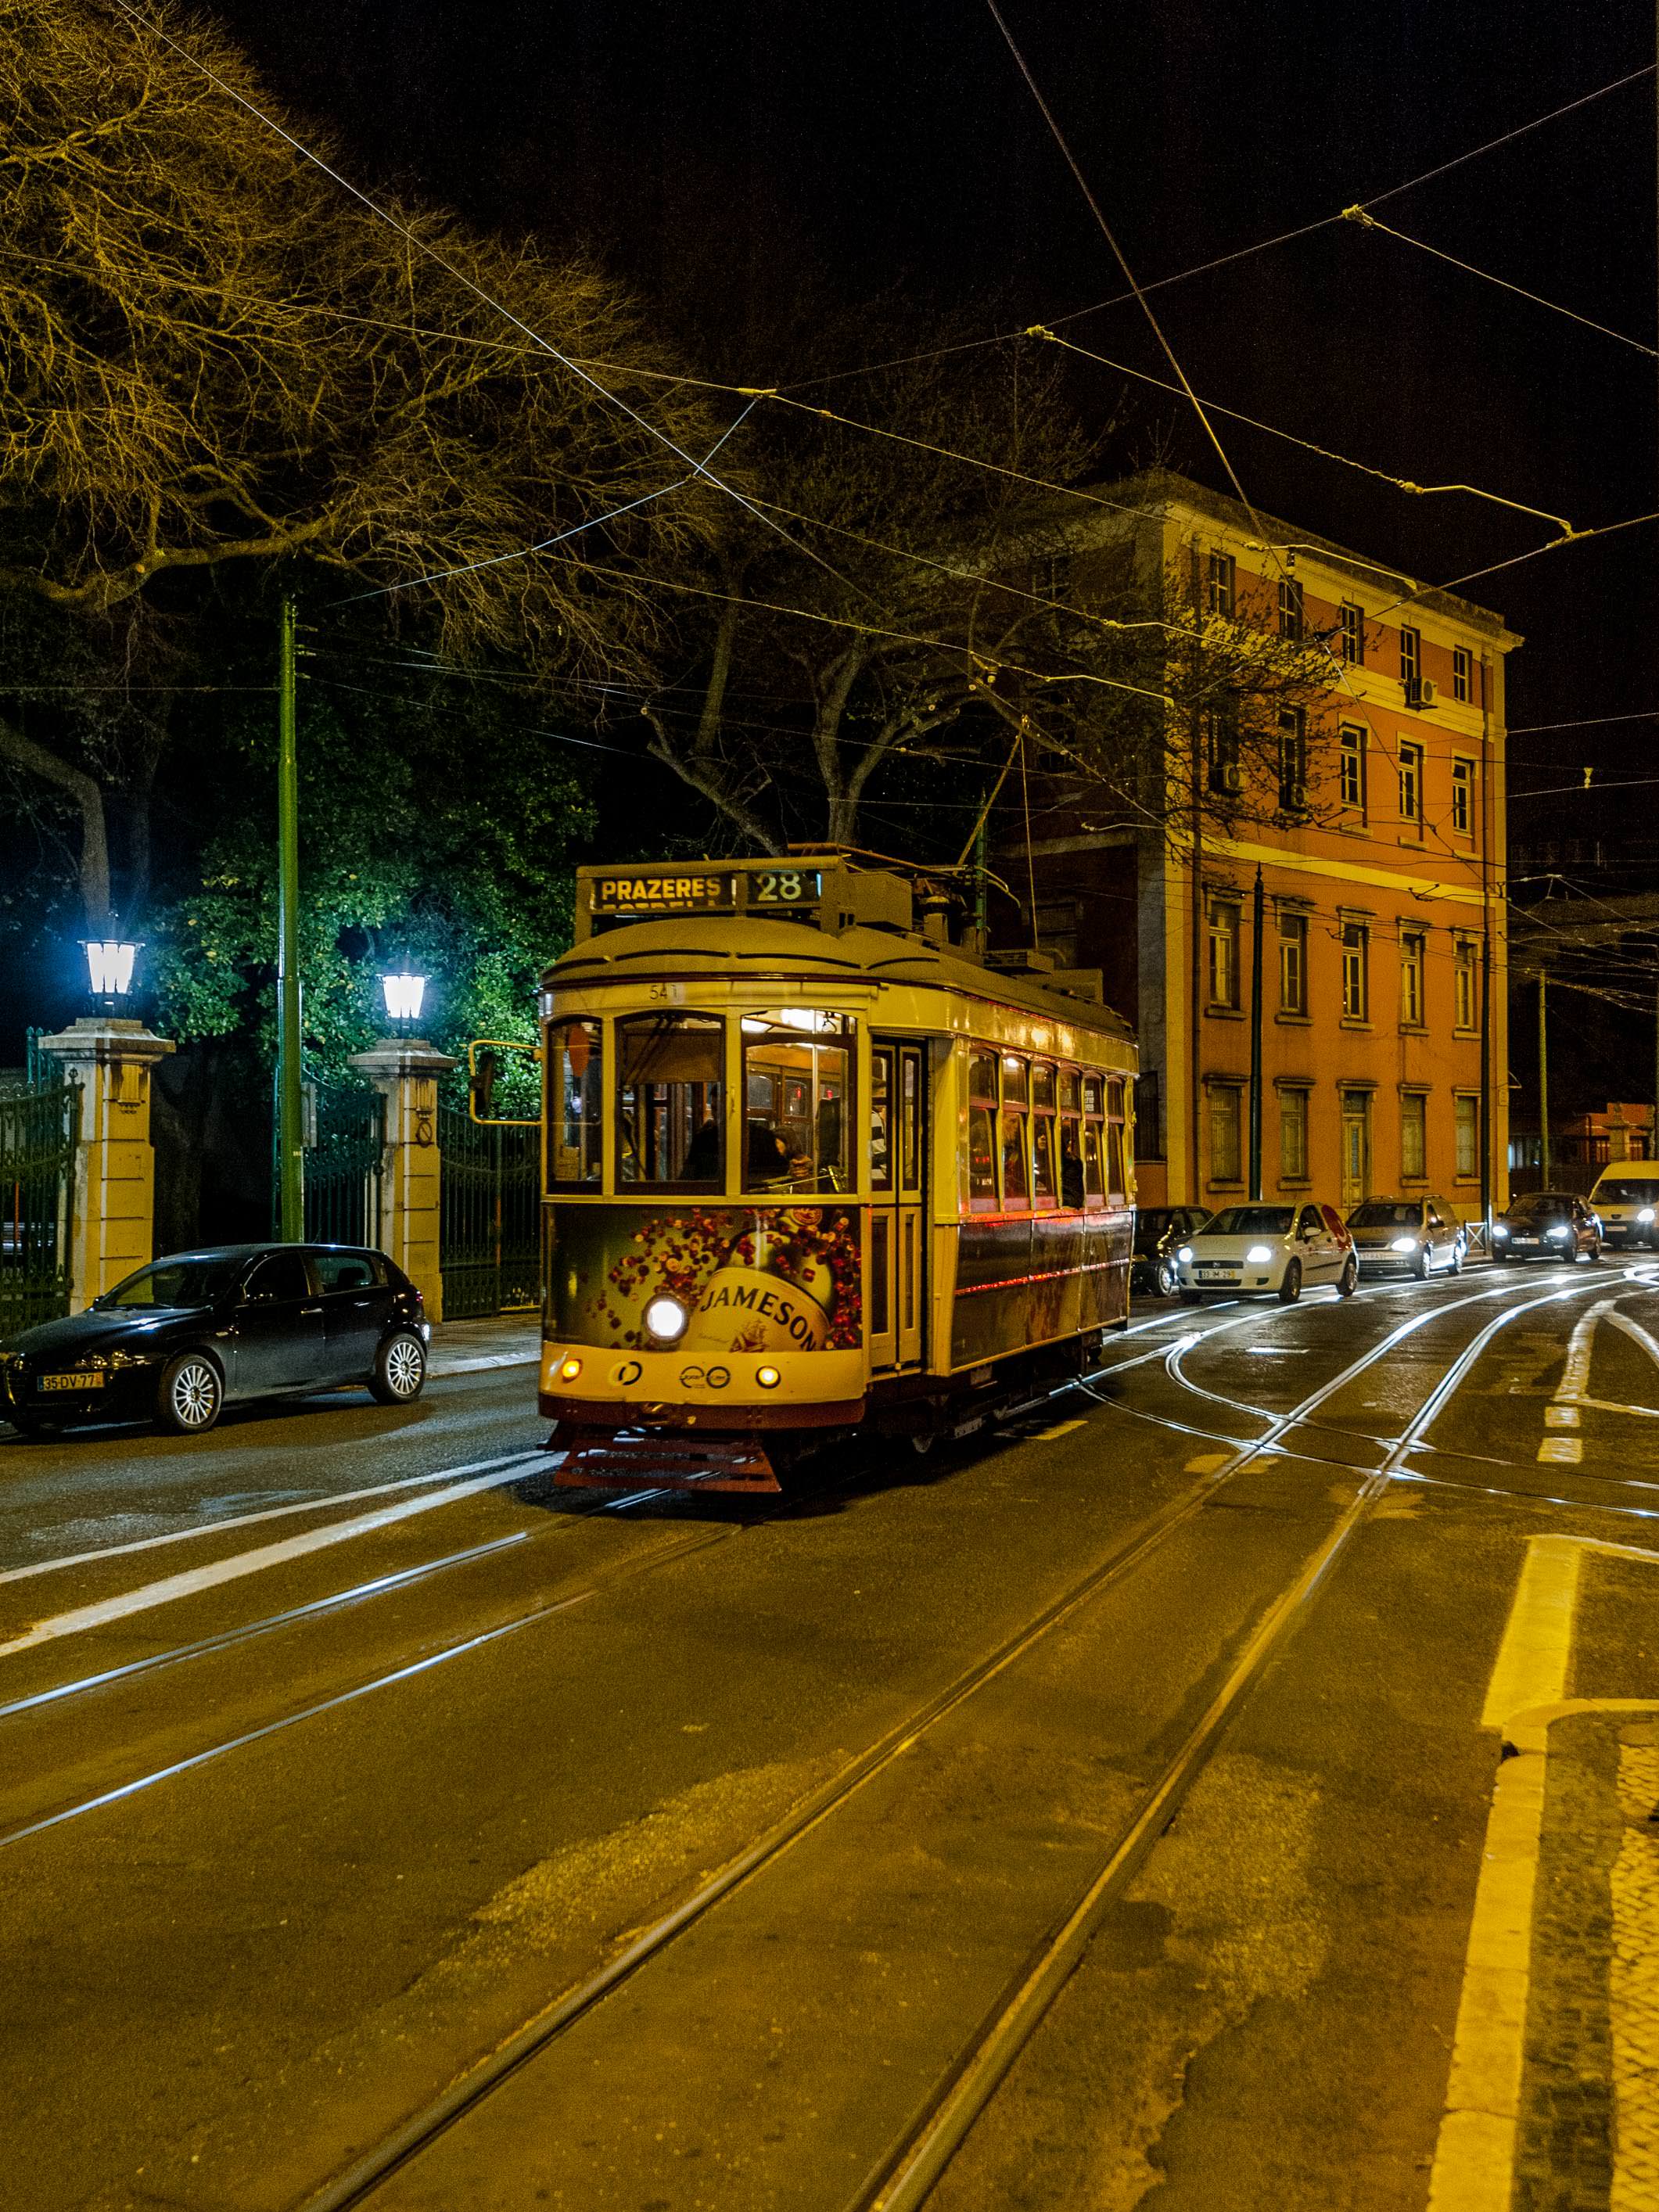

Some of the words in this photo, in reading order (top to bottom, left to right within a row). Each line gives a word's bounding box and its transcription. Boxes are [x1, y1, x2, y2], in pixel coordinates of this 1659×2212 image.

[601, 877, 721, 900] PRAZERES
[756, 871, 803, 901] 28
[700, 1285, 817, 1352] JAMESON
